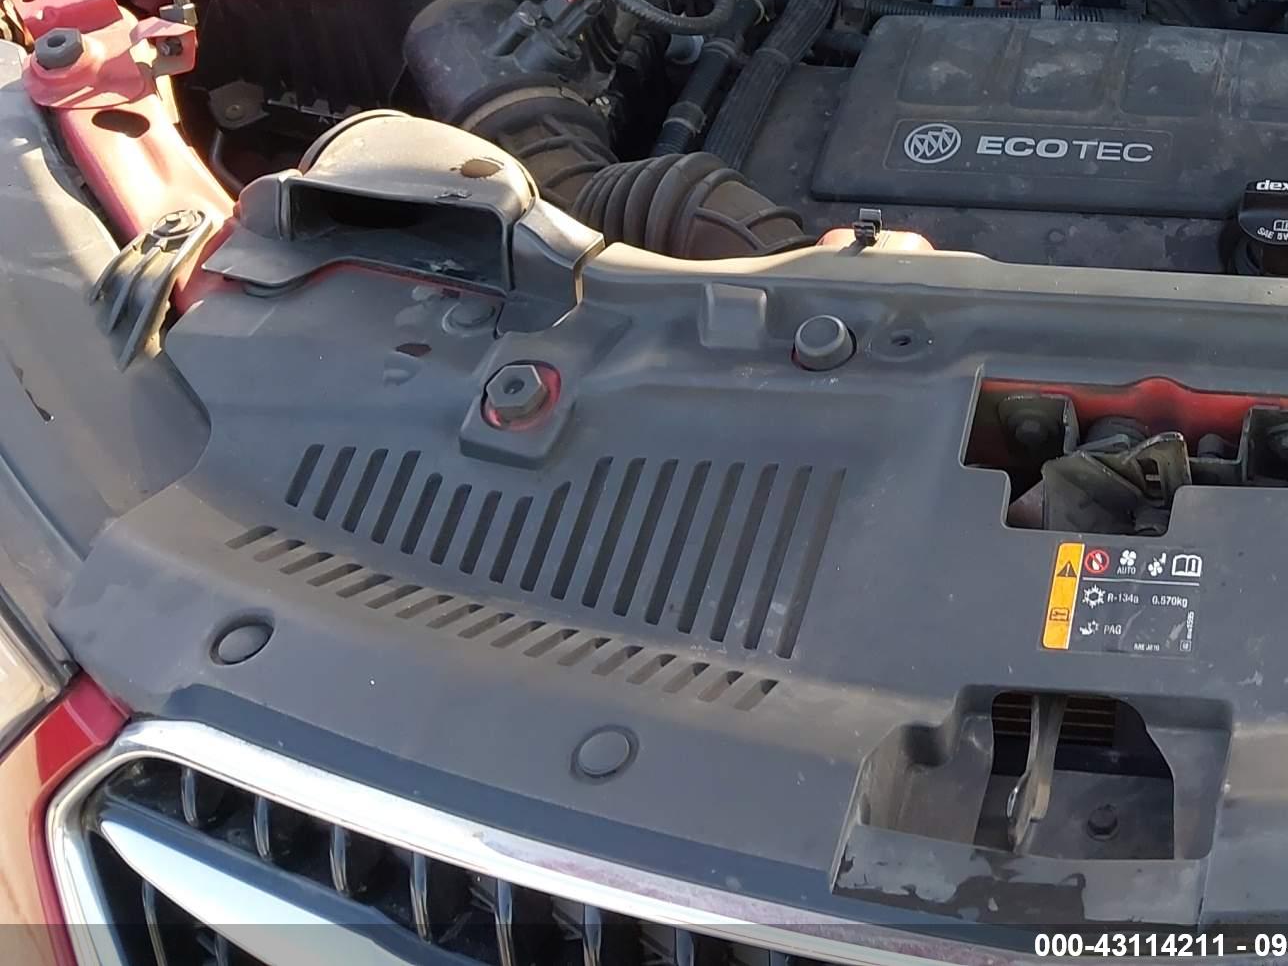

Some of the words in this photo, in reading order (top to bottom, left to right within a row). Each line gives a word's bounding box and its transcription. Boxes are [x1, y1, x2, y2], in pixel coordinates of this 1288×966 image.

[976, 135, 1154, 163] ECOTEC
[1257, 227, 1274, 240] SAE
[1116, 566, 1136, 575] AUTO
[1107, 592, 1139, 604] R-134a
[1103, 624, 1122, 635] PAG
